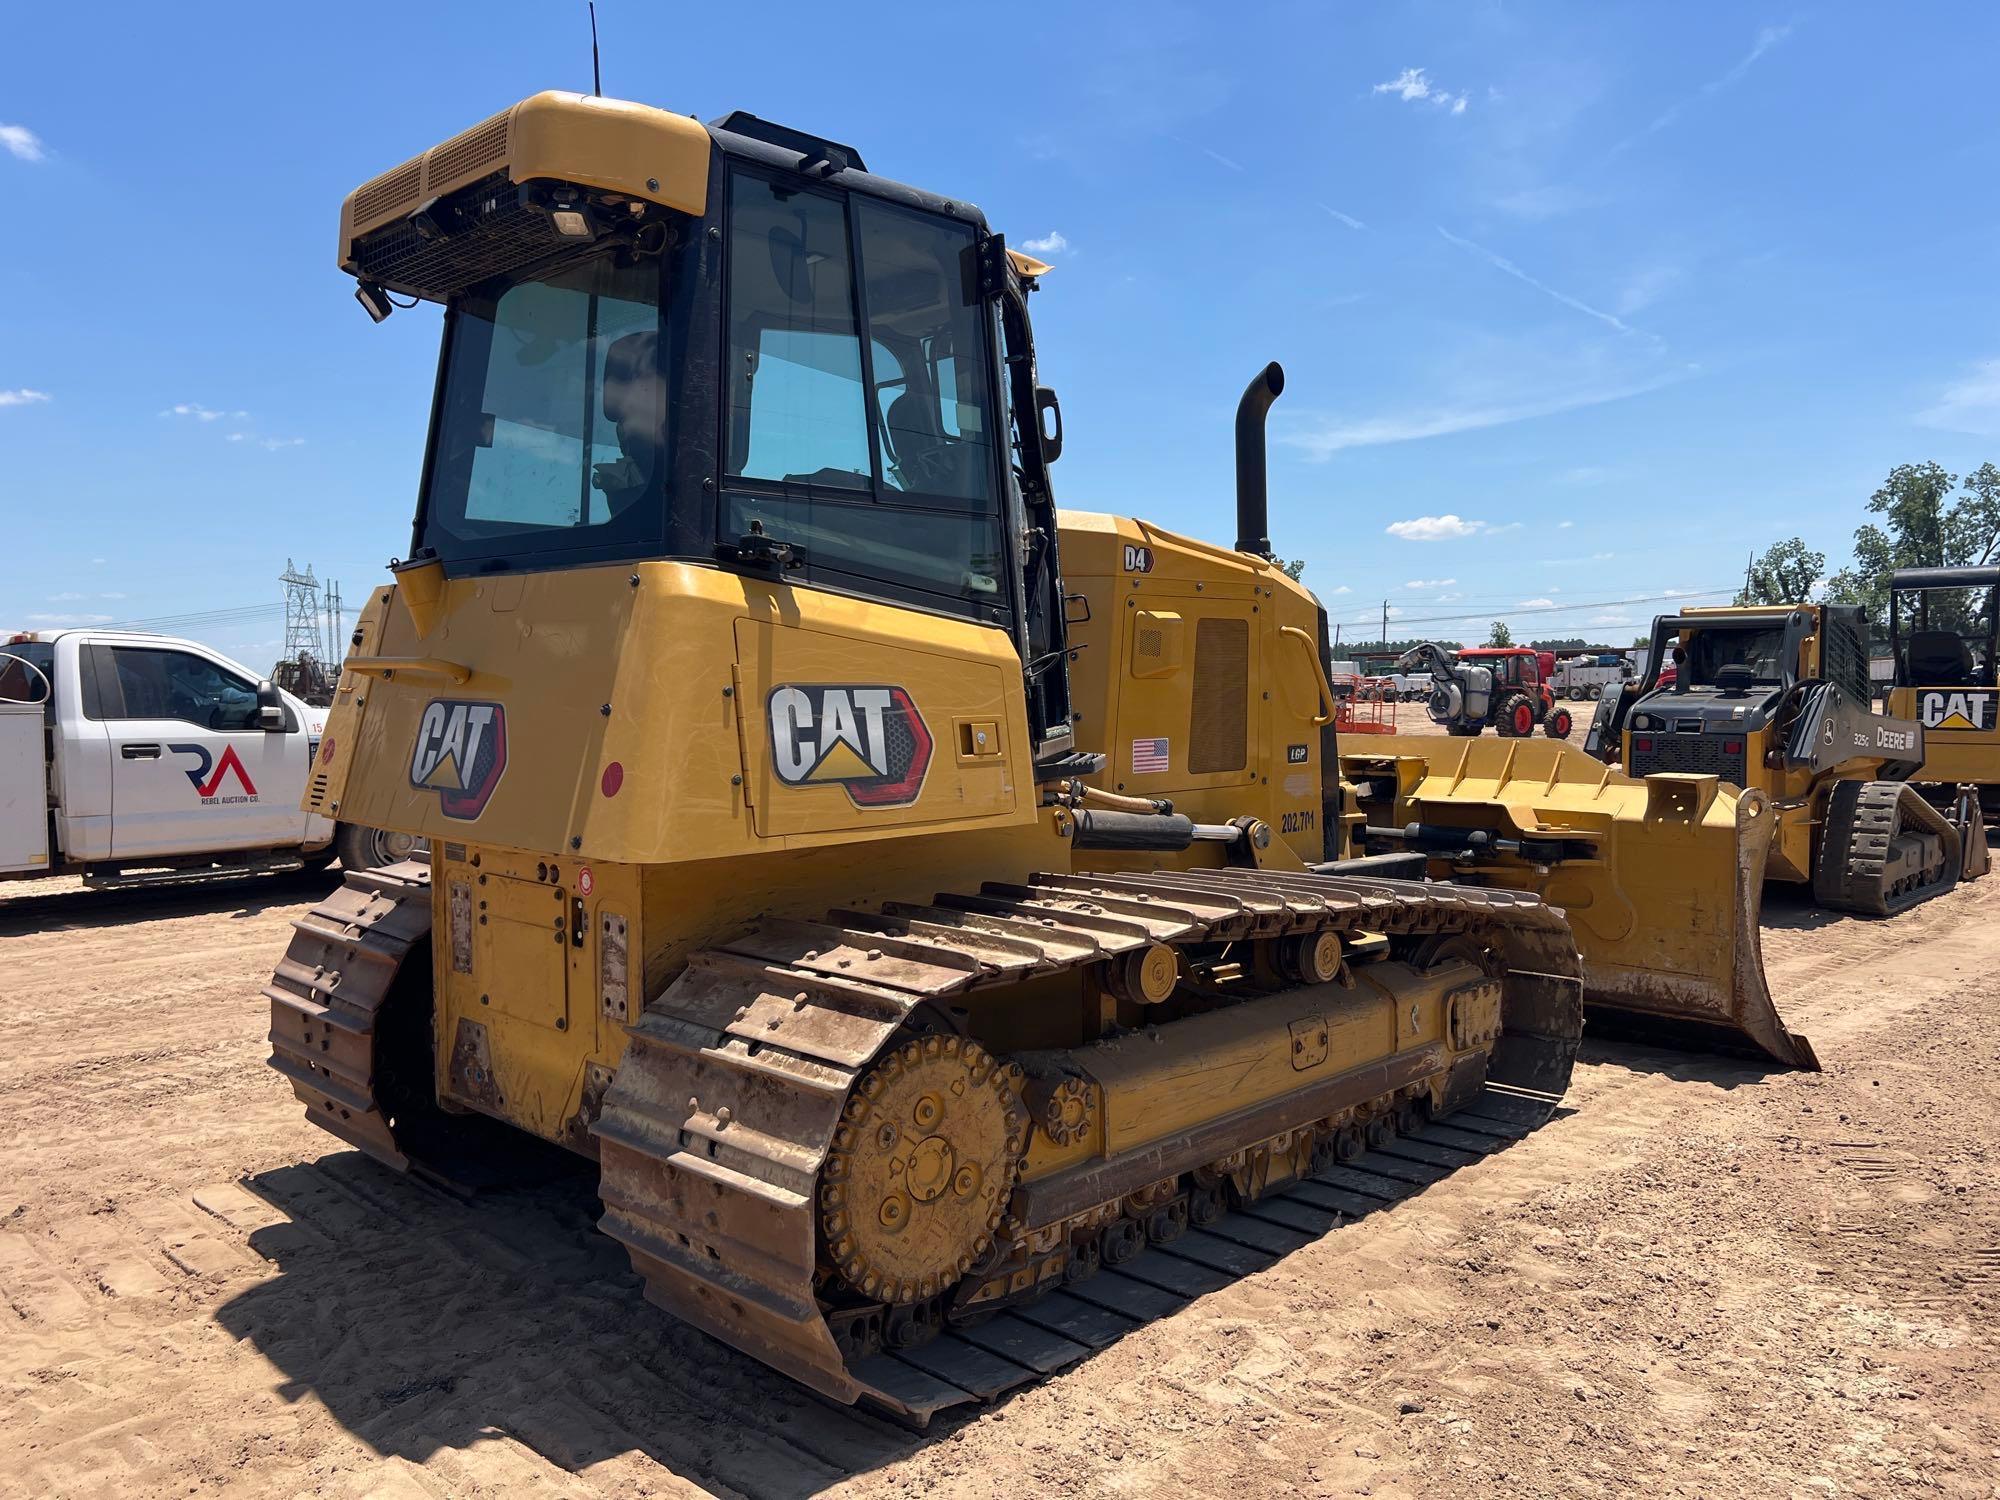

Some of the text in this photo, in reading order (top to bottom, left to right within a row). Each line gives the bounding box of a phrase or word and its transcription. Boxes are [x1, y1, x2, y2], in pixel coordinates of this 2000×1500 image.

[1125, 546, 1146, 572] D4
[1923, 692, 1990, 729] CAT
[412, 702, 494, 790] CAT
[771, 688, 891, 781] CAT
[1853, 732, 1870, 747] 325G
[1876, 726, 1905, 750] DEERE
[1290, 748, 1306, 761] LGP
[167, 744, 258, 797] RA
[201, 797, 220, 805] REBEL
[222, 795, 248, 804] AUCTION
